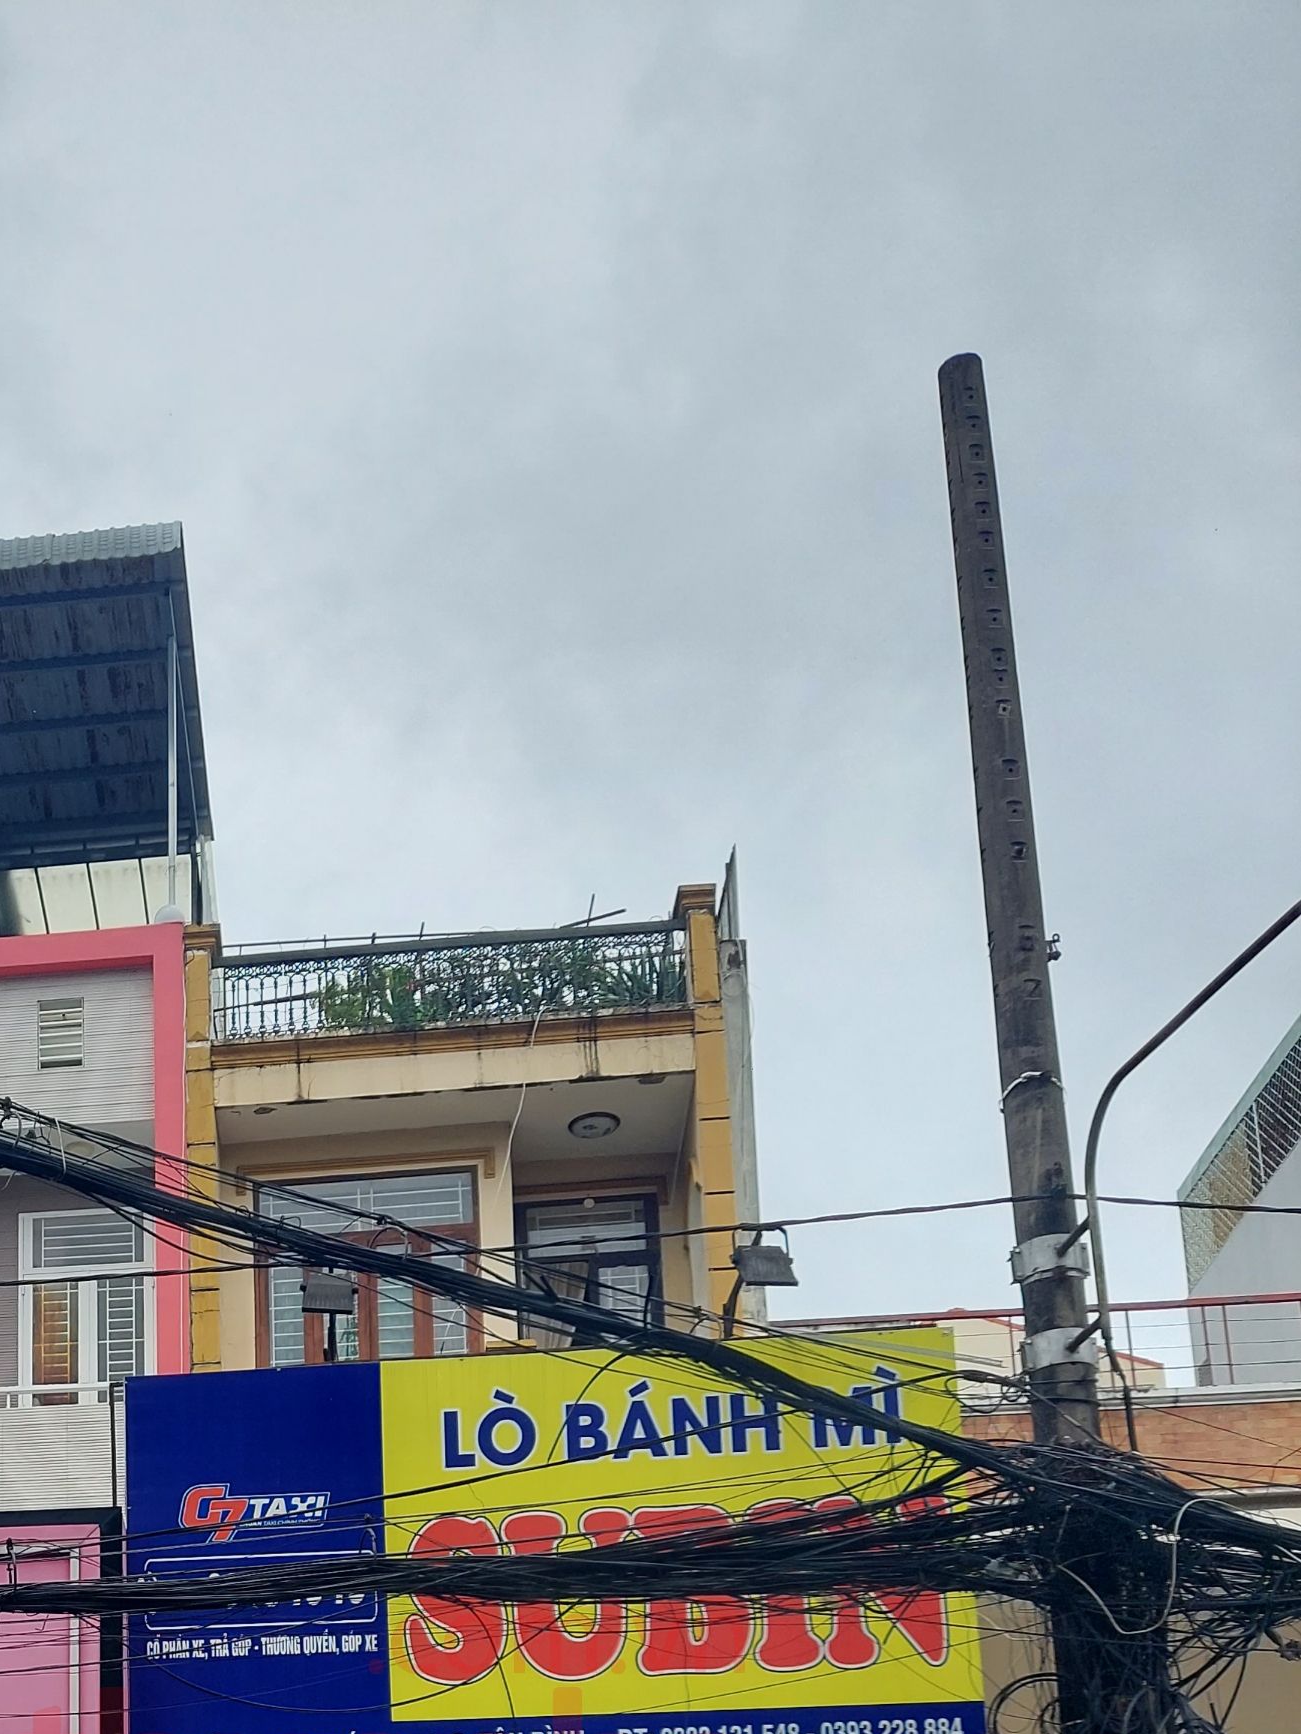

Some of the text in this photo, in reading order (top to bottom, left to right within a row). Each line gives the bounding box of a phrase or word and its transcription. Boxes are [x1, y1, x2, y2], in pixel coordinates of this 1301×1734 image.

[442, 1388, 537, 1469] LÒ
[562, 1380, 781, 1463] BÁNH
[249, 1495, 325, 1519] TAXI
[341, 1629, 362, 1653] GÓP
[365, 1634, 379, 1652] XE
